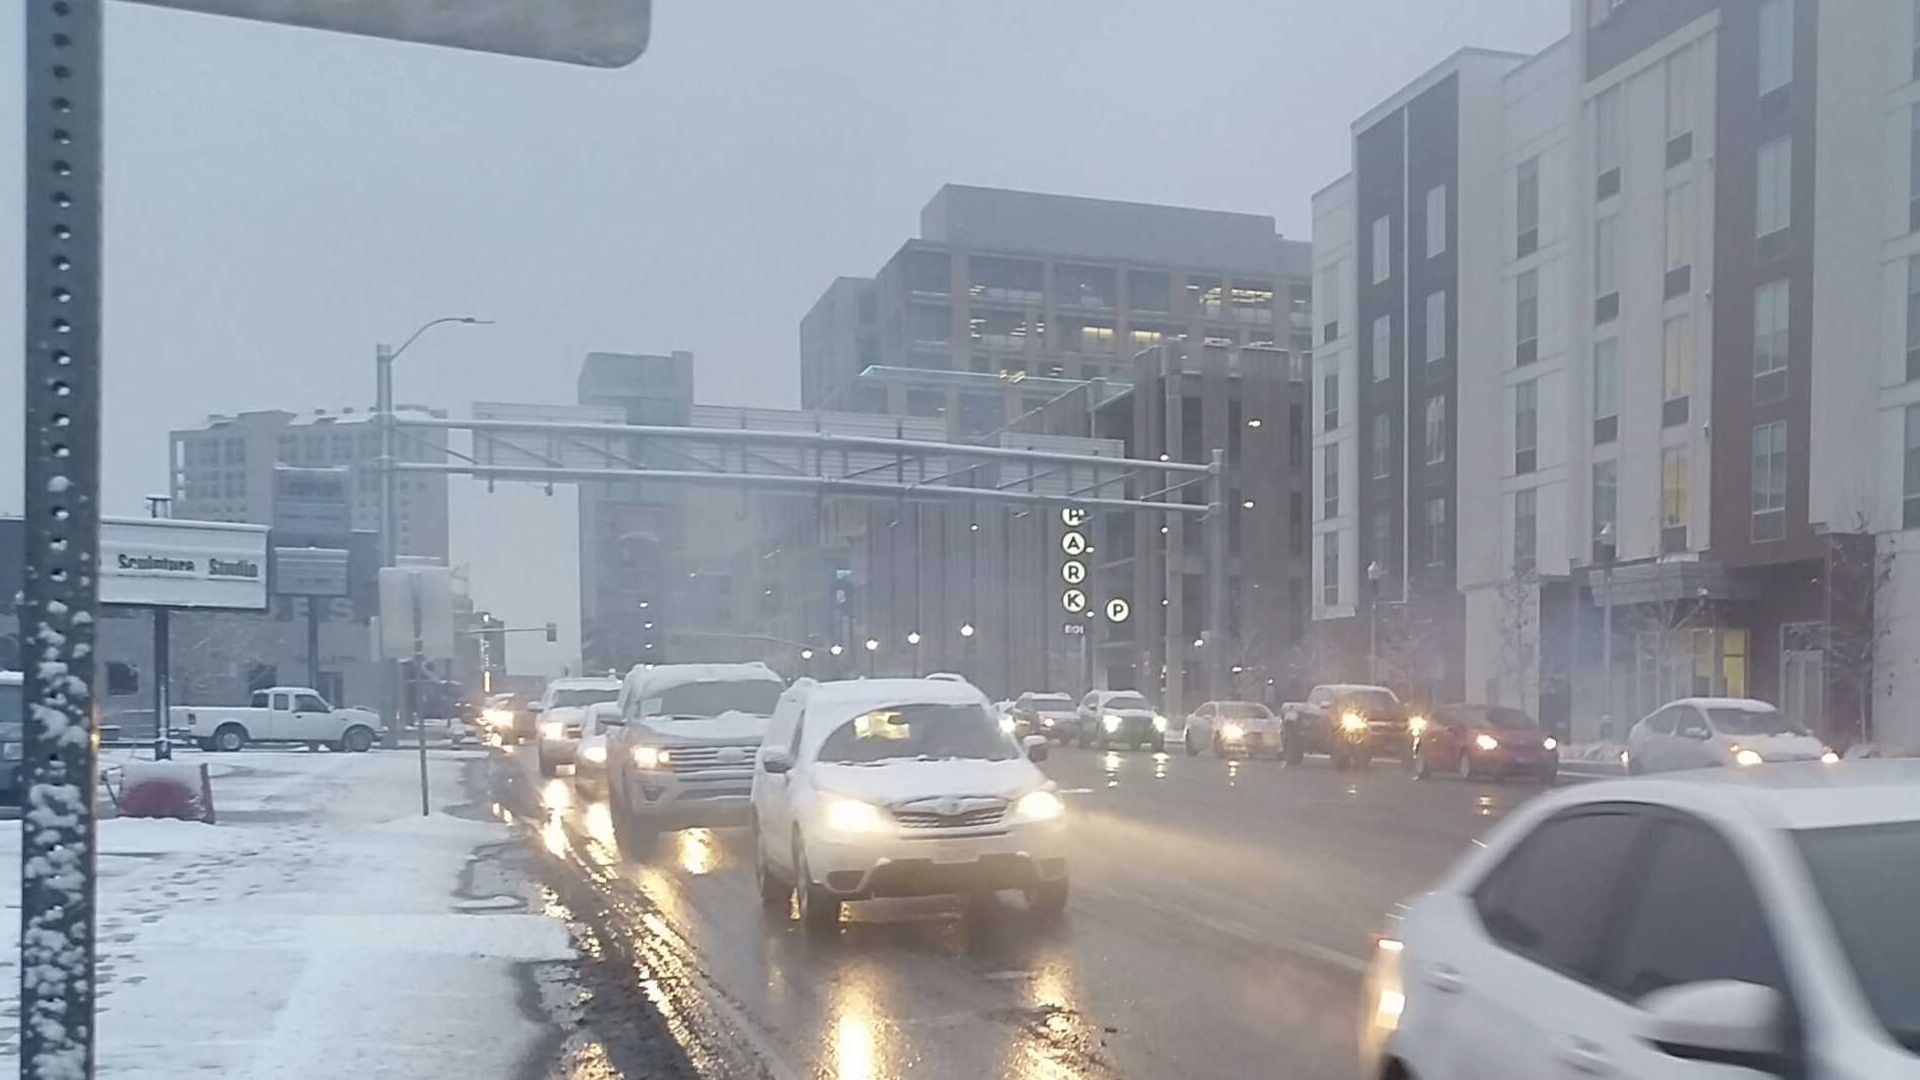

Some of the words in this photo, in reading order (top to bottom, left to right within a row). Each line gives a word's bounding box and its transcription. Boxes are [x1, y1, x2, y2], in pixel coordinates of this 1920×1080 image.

[118, 554, 194, 572] Sculpture
[209, 558, 258, 578] Studio
[1113, 603, 1124, 617] P
